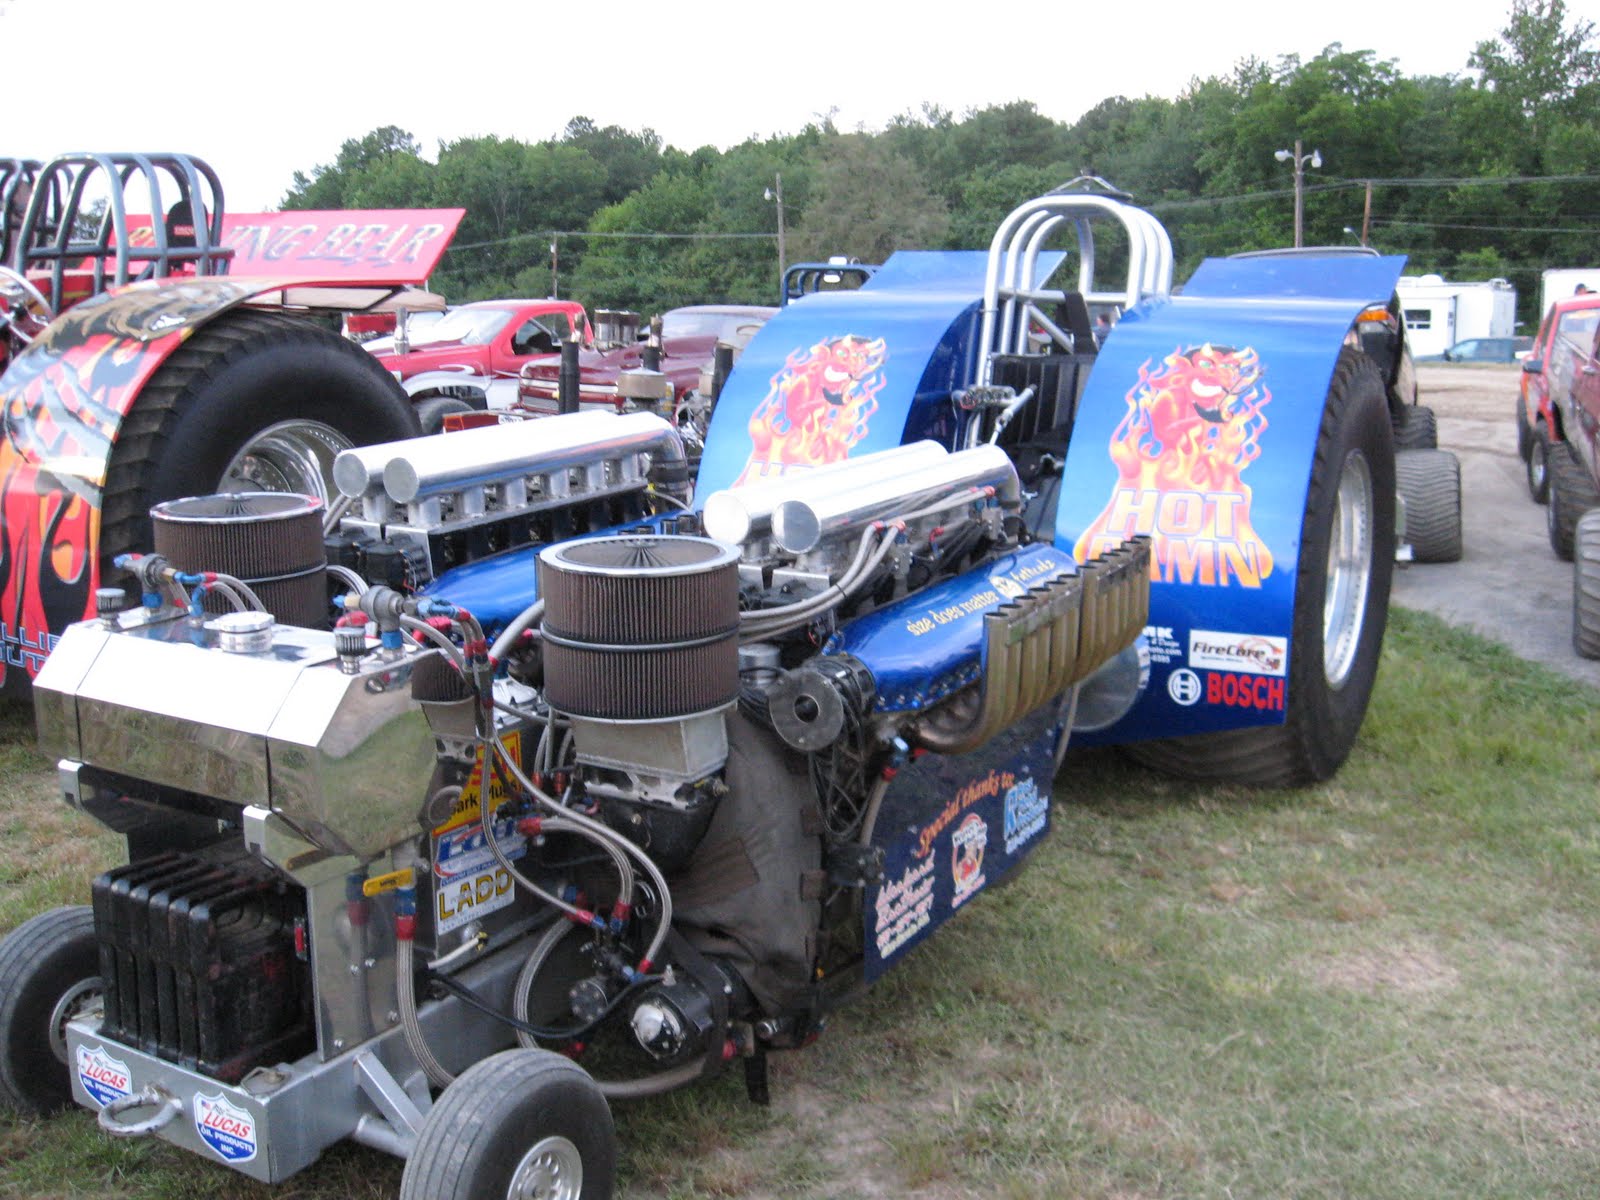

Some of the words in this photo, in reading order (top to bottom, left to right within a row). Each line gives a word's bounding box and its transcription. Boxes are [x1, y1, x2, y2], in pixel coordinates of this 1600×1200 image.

[298, 223, 444, 266] BEAR
[1107, 489, 1245, 539] HOT
[907, 618, 936, 636] size
[928, 606, 965, 624] does
[959, 590, 999, 614] matter
[1207, 672, 1284, 711] BOSCH
[916, 787, 963, 859] Special
[962, 769, 1001, 808] thanks
[439, 867, 512, 921] LADD
[86, 1063, 127, 1089] LUCAS
[95, 1082, 125, 1099] PRODUC
[201, 1125, 213, 1138] OIL
[214, 1131, 254, 1153] PRODUCTS
[204, 1111, 251, 1138] LUCAS
